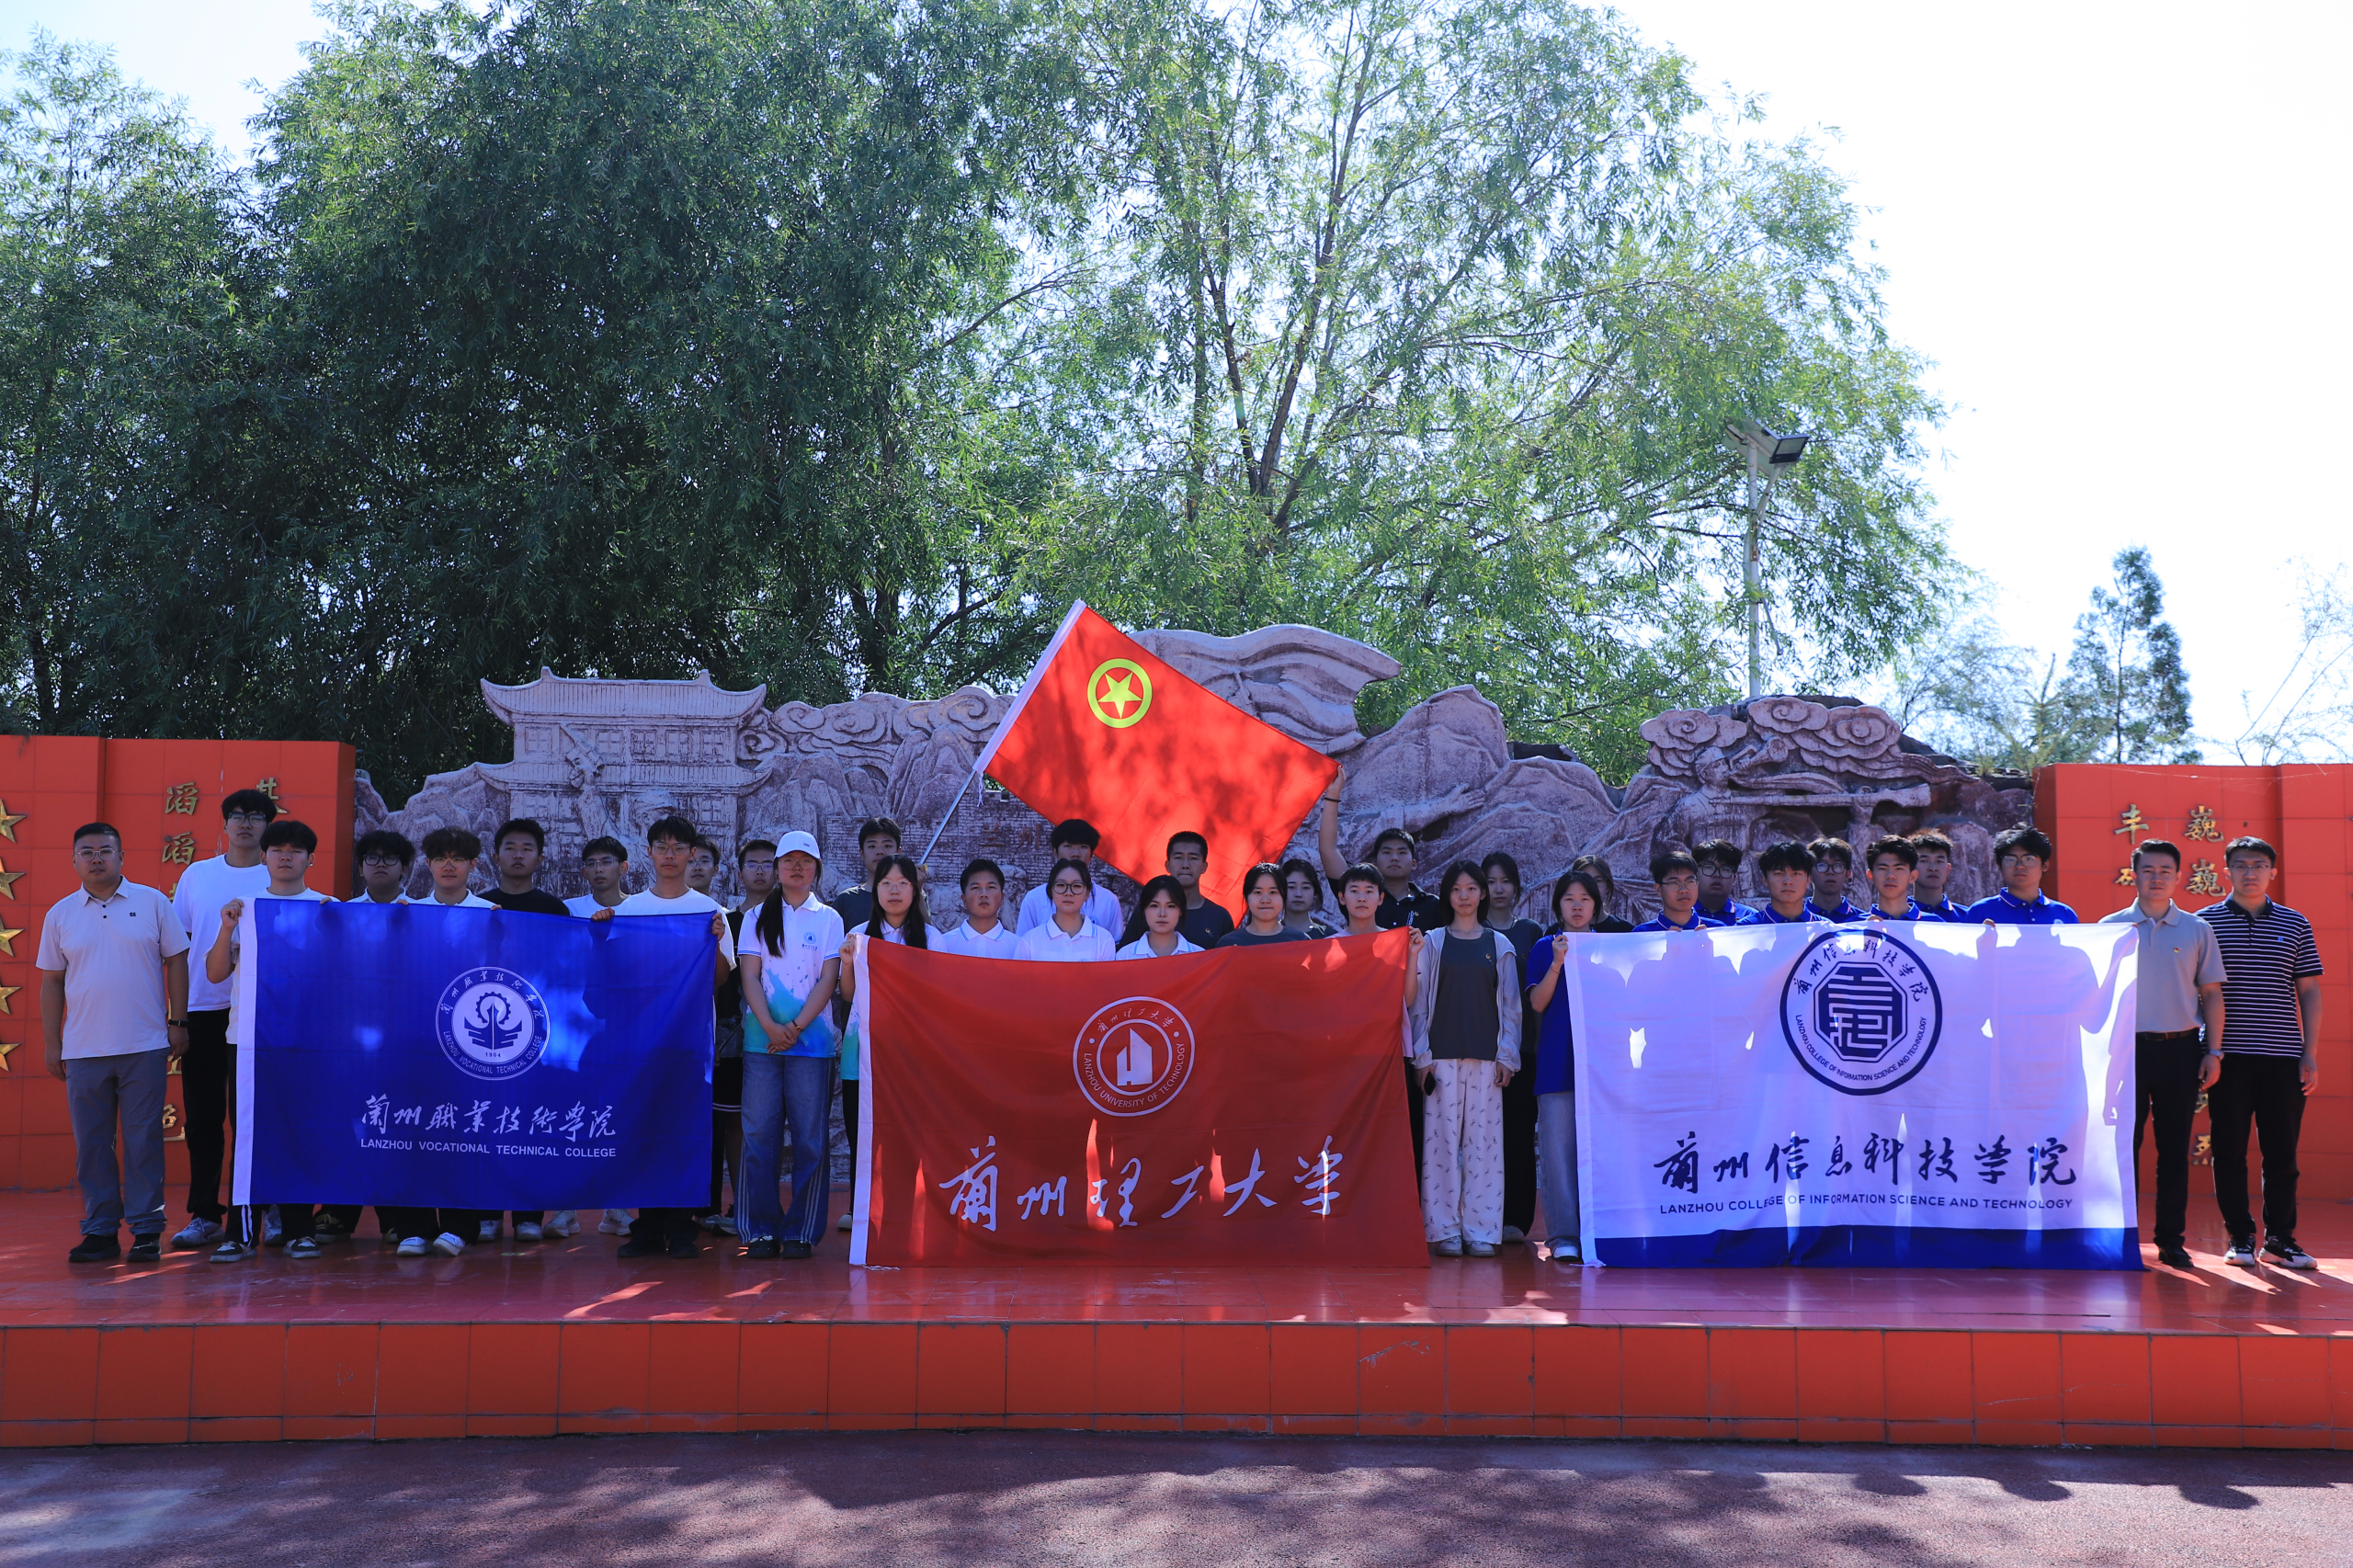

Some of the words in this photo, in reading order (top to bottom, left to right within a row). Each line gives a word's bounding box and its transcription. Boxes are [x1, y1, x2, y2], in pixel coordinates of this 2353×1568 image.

[978, 823, 1042, 849] 兰州
[443, 1030, 460, 1057] LANZHOU
[459, 1055, 494, 1074] VOCATIONAL
[496, 1059, 528, 1074] TECHNICAL
[525, 1035, 542, 1060] COLLEGE
[1795, 1014, 1810, 1045] LANZHOU
[1805, 1041, 1829, 1068] COLLEGE
[1828, 1063, 1837, 1073] OF
[1836, 1067, 1873, 1082] INFORMATION
[1873, 1065, 1898, 1080] SCIENCE
[1897, 1054, 1910, 1067] AND
[1906, 1017, 1927, 1059] TECHNOLOGY
[1084, 1052, 1101, 1092] LANZHOU
[1099, 1089, 1145, 1108] UNIVERSITY
[1147, 1091, 1159, 1103] OF
[1159, 1042, 1186, 1095] TECHNOLOGY
[360, 1138, 413, 1150] LANZHOU
[418, 1141, 490, 1153] VOCATIONAL
[496, 1144, 560, 1156] TECHNICAL
[564, 1147, 617, 1158] COLLEGE
[1660, 1201, 1724, 1214] LANZHOU
[1728, 1195, 1784, 1210] COLLEGE
[1788, 1194, 1807, 1205] OF
[1809, 1193, 1887, 1206] INFORMATION
[1890, 1194, 1945, 1208] SCIENCE
[1949, 1196, 1978, 1208] AND
[1984, 1198, 2073, 1210] TECHNOLOGY
